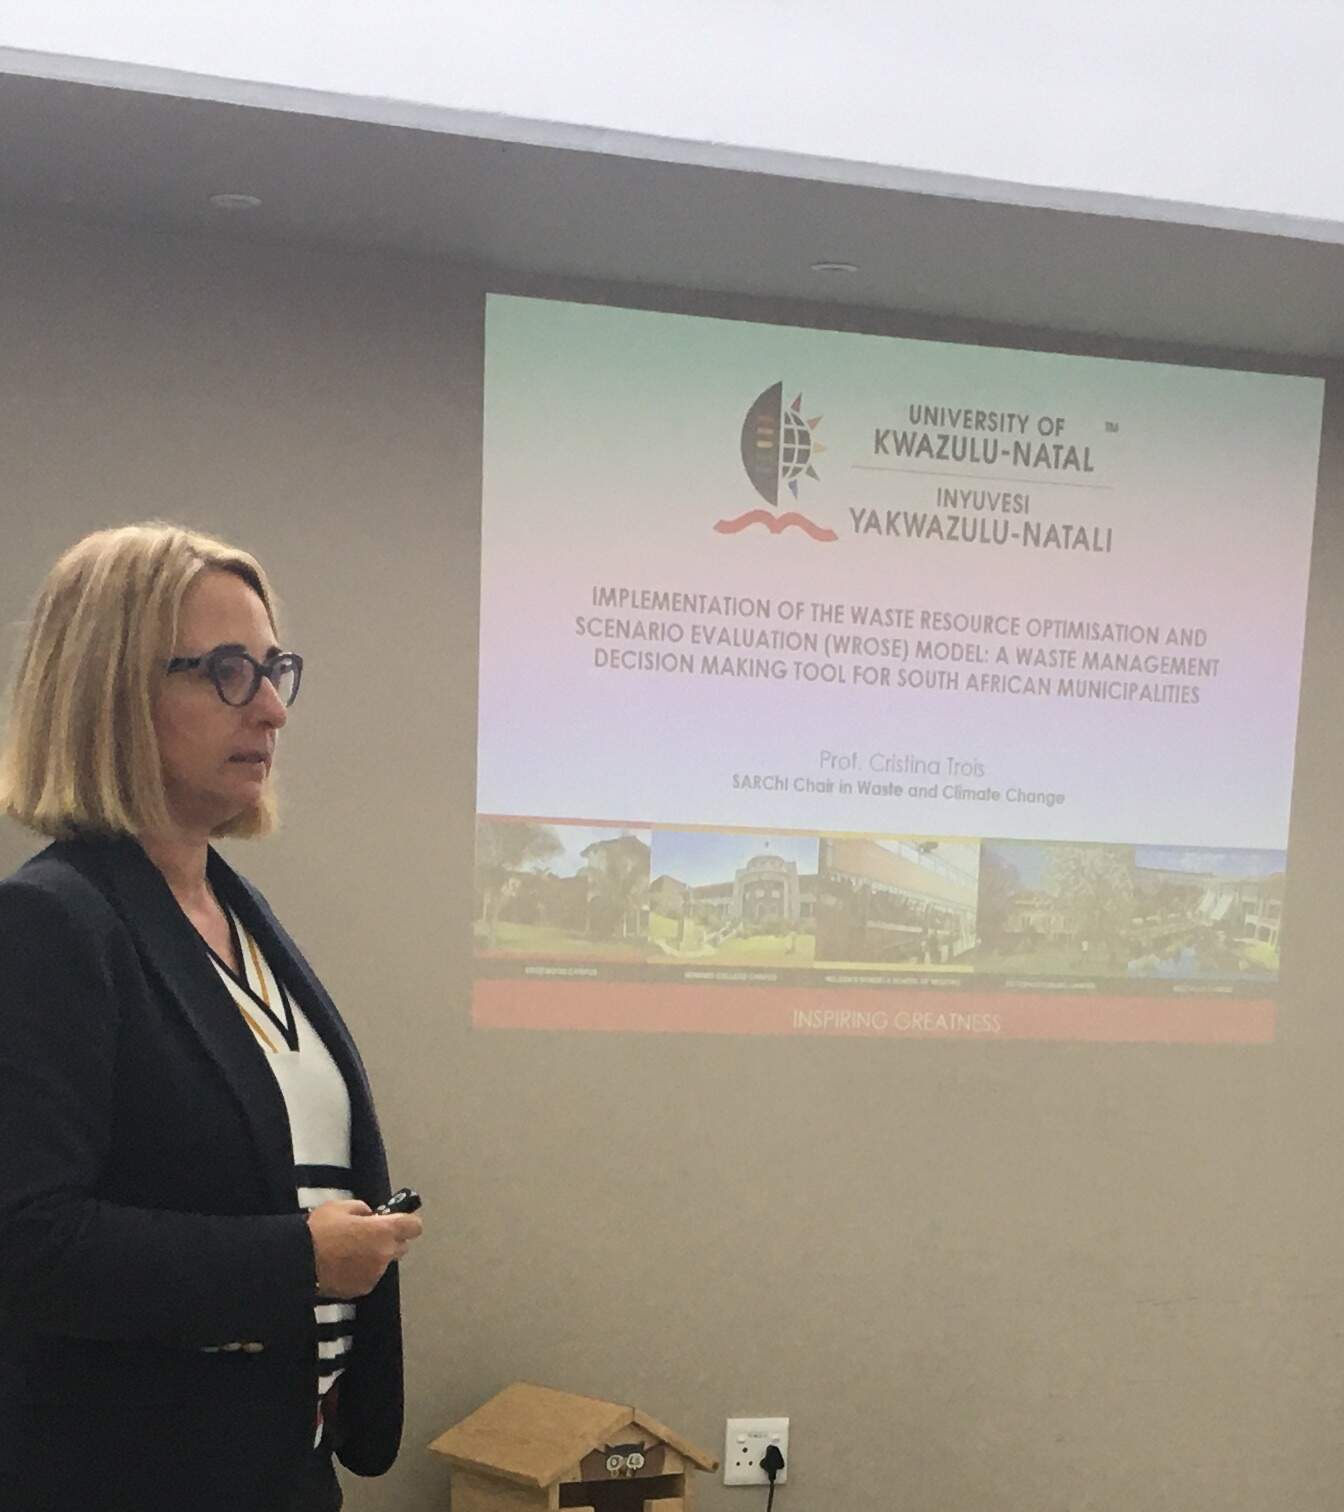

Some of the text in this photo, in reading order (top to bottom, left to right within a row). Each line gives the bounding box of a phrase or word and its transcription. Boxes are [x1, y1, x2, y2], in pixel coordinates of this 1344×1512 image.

[909, 404, 1065, 437] UNIVERSITY OF
[874, 429, 1094, 472] KWAZULU-NATAL
[937, 487, 1029, 514] INYUVESI
[849, 507, 1112, 552] YAKWAZULU-NATALI
[592, 586, 1207, 647] IMPLEMENTATION OF THE WASTE RESOURCE OPTIMISATION AND
[576, 616, 1219, 676] SCENARIO EVALUATION (WROSE) MODEL: A WASTE MANAGEMENT
[594, 648, 1199, 704] DECISION MAKING TOOL FOR SOUTH AFRICAN MUNICIPALITIES
[869, 752, 941, 775] Cristina
[947, 756, 985, 778] Trois
[793, 777, 835, 793] Chair
[839, 779, 853, 794] in
[857, 780, 904, 797] Waste
[908, 784, 938, 798] and
[942, 784, 1001, 801] Climate
[1006, 787, 1065, 808] Change
[793, 1009, 1001, 1034] INSPIRING GREATNESS
